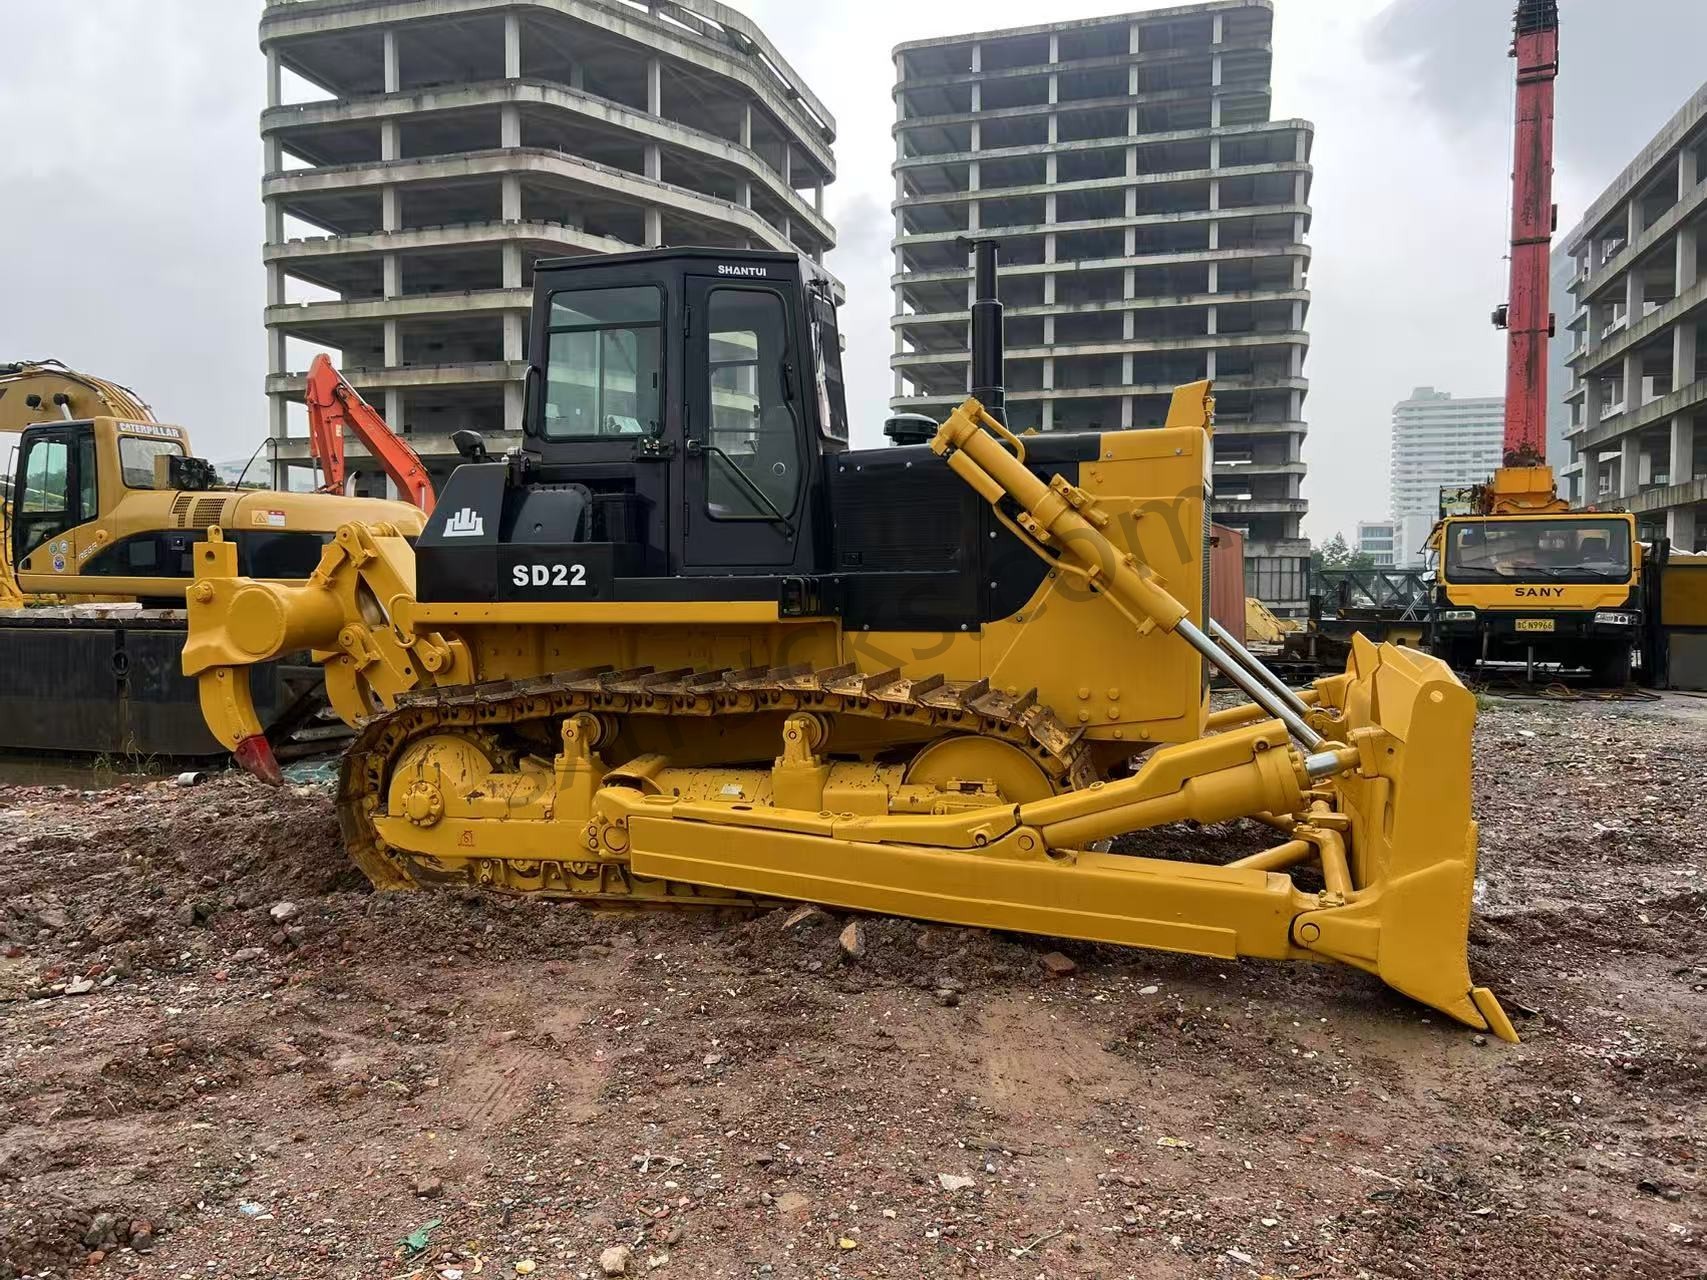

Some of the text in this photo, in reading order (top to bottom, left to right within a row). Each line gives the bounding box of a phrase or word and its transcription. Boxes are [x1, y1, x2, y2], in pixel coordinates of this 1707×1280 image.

[717, 264, 767, 277] SHANTUI
[119, 422, 180, 438] CATERPILLAR
[512, 564, 587, 587] SD22
[1514, 587, 1565, 597] SANY
